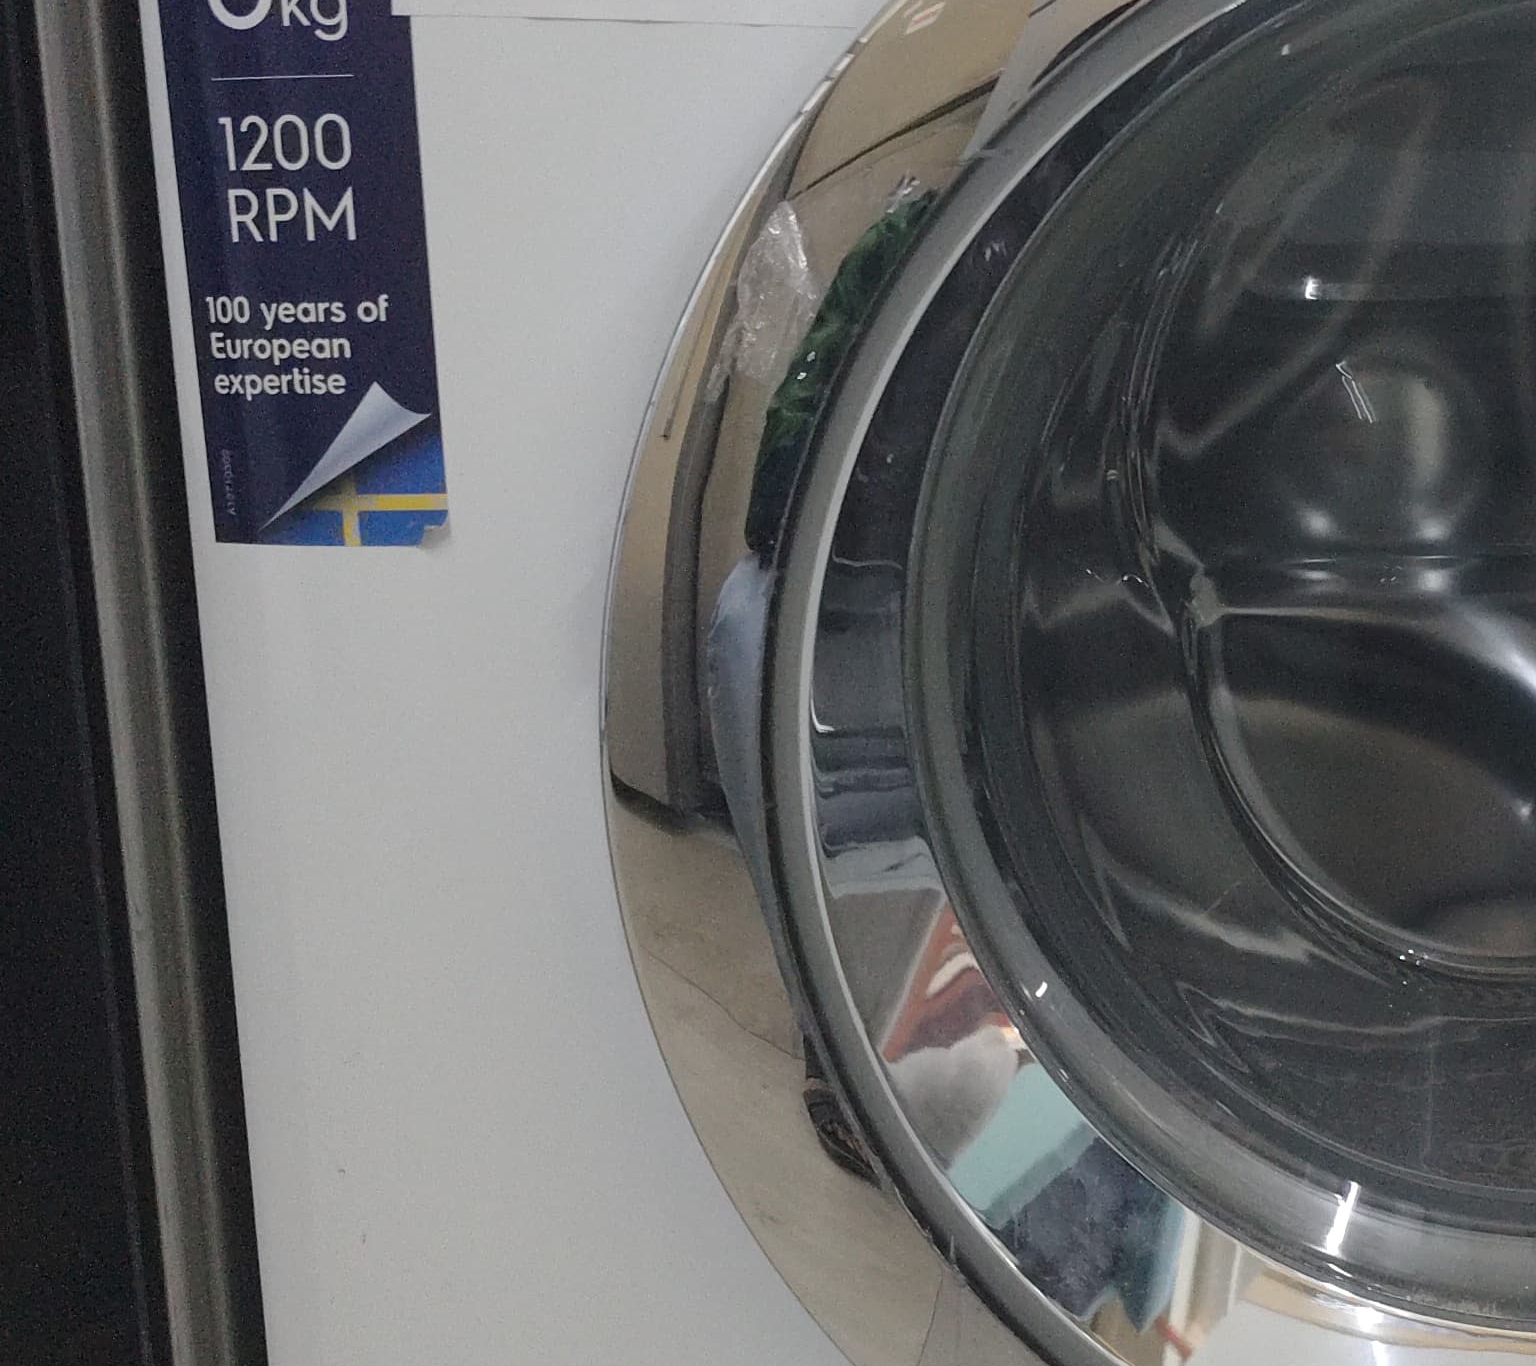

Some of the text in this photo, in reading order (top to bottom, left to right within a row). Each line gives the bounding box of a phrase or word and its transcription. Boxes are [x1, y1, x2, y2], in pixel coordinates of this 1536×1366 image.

[217, 113, 352, 172] 1200
[226, 186, 357, 243] RPM
[205, 294, 390, 331] 100 years of
[210, 332, 352, 366] European
[214, 369, 346, 402] expertise
